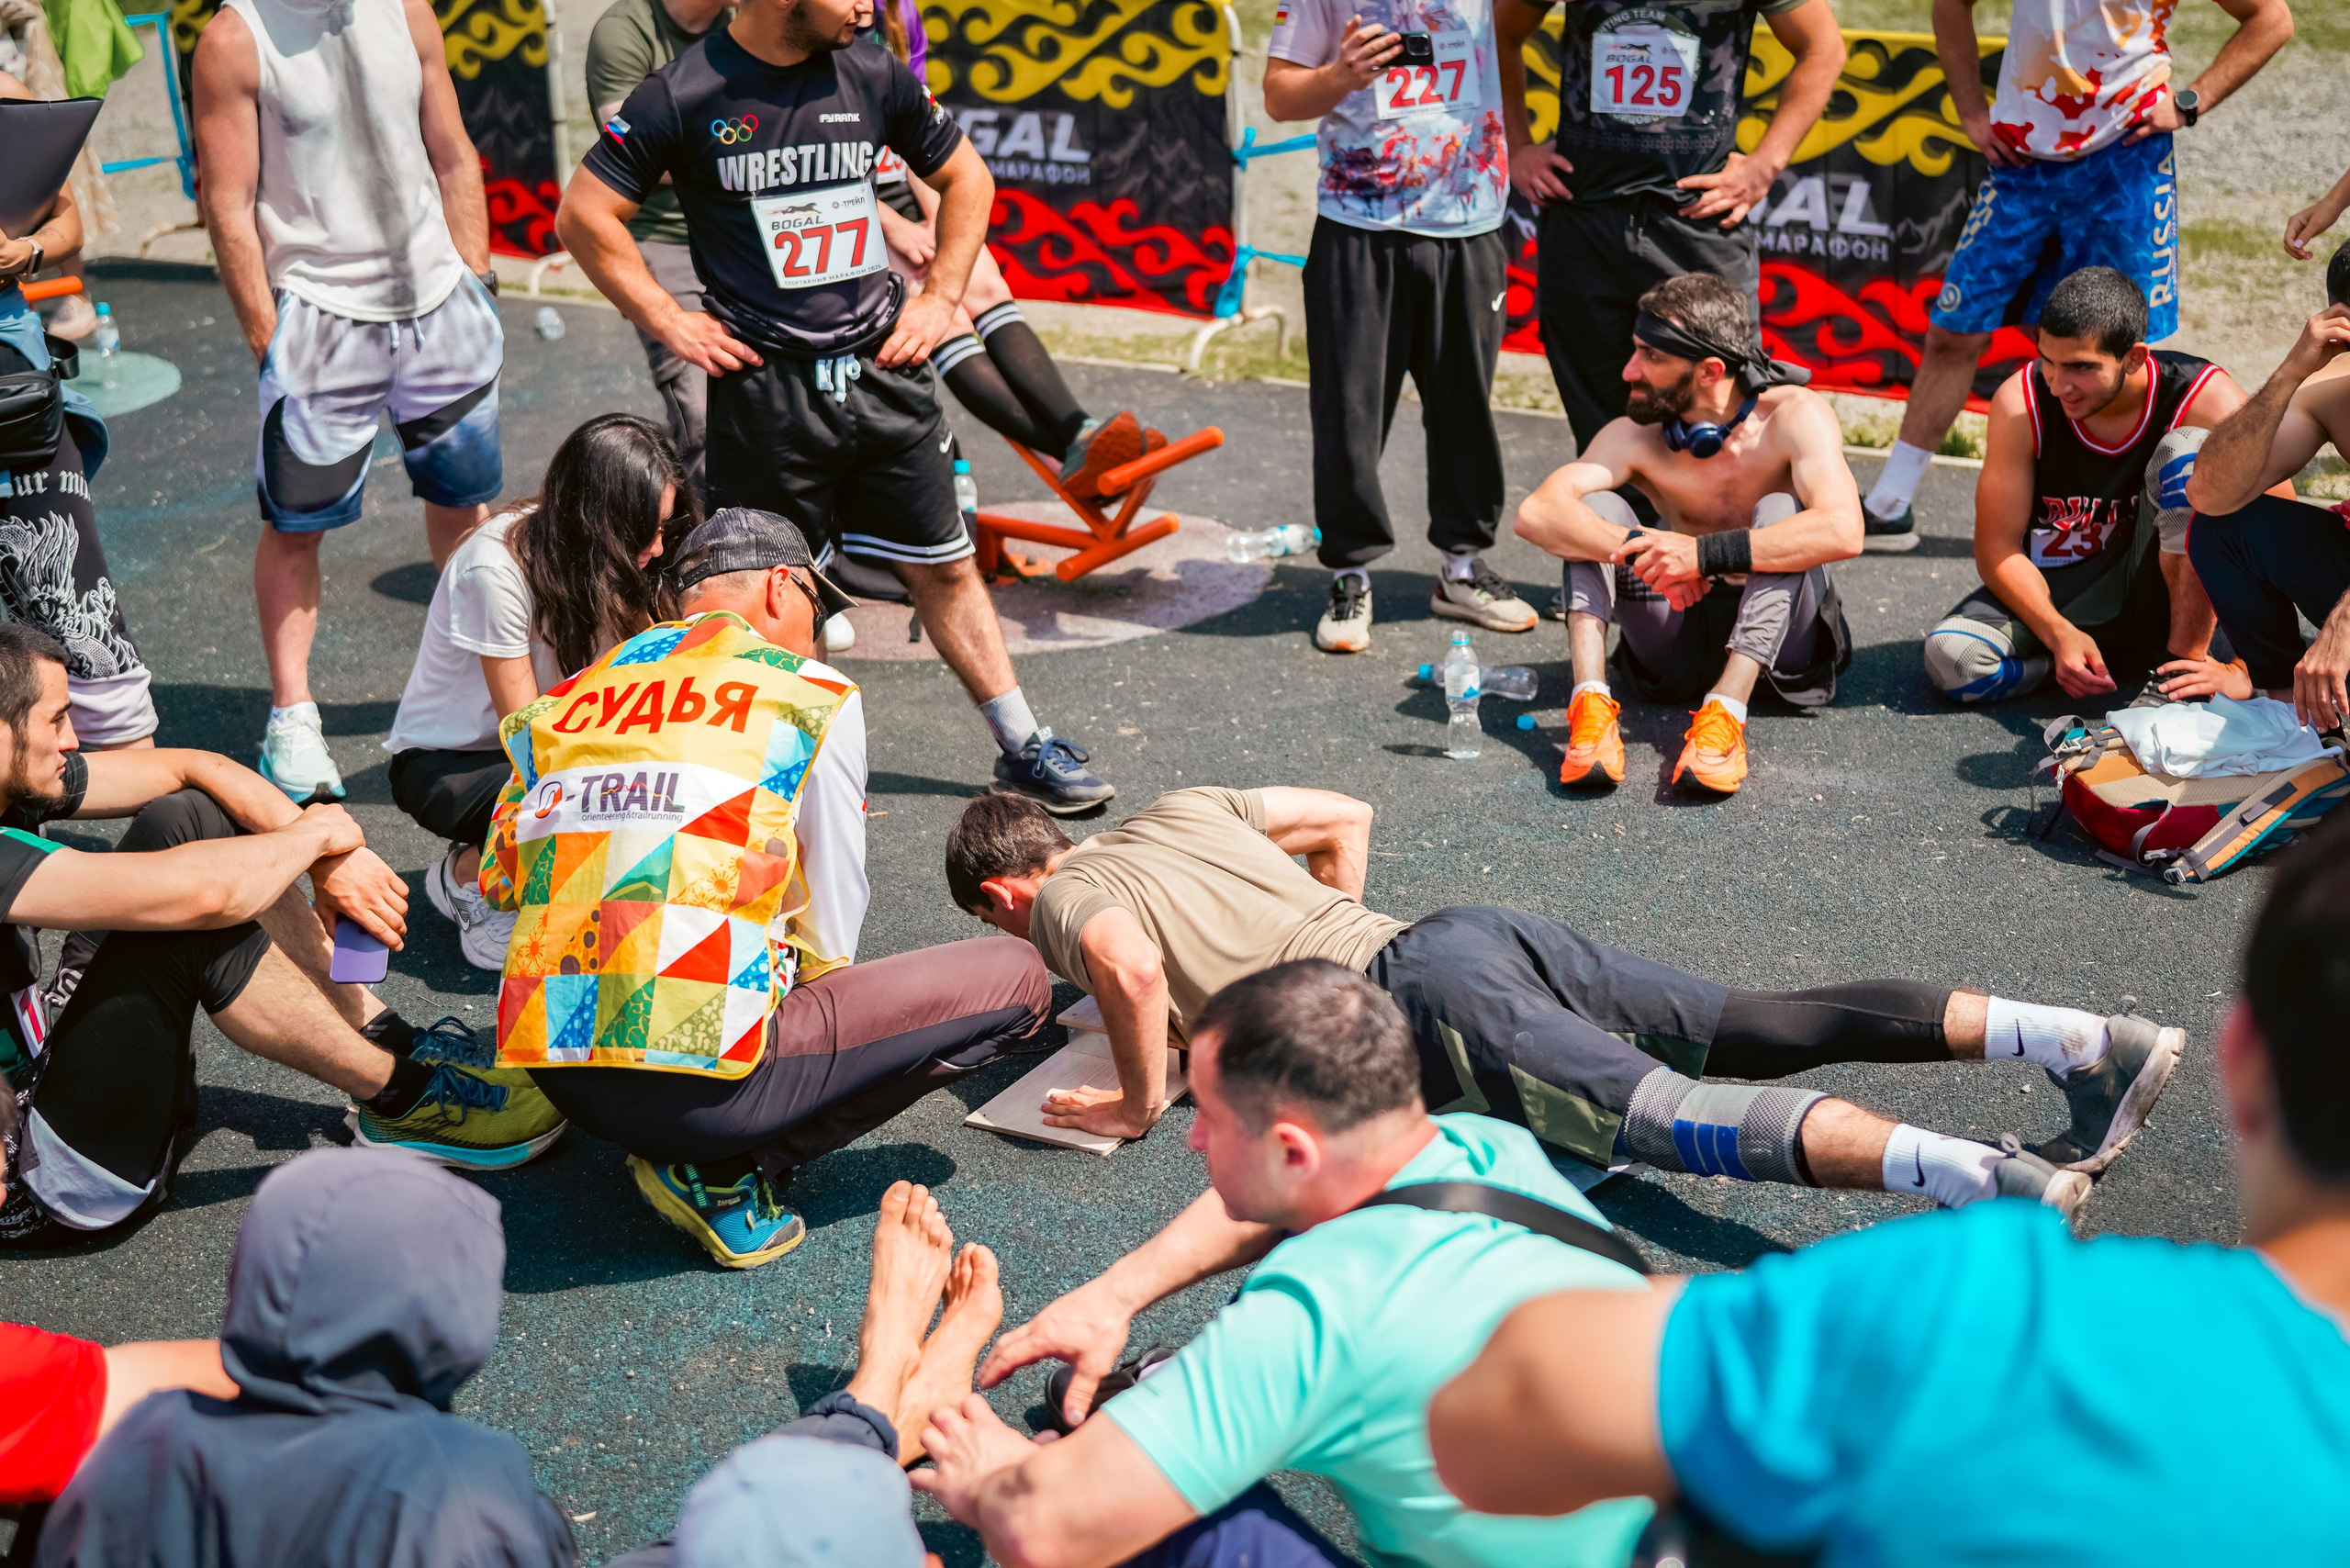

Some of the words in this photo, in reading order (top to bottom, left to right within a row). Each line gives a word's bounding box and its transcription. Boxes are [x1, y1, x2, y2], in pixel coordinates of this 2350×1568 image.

[1632, 9, 1666, 23] TEAM
[1606, 54, 1653, 64] BOGAL
[1386, 59, 1467, 108] 227
[1605, 64, 1682, 107] 125
[948, 107, 1091, 164] GAL
[717, 140, 874, 192] WRESTLING
[771, 215, 824, 230] BOGAL
[2149, 149, 2174, 308] RUSSIA
[774, 216, 870, 278] 277
[1753, 230, 1889, 263] МАРАФОН
[828, 268, 867, 281] МАРАФОН
[552, 676, 760, 735] СУДЬЯ
[581, 811, 684, 823] orienteering&trailrunning
